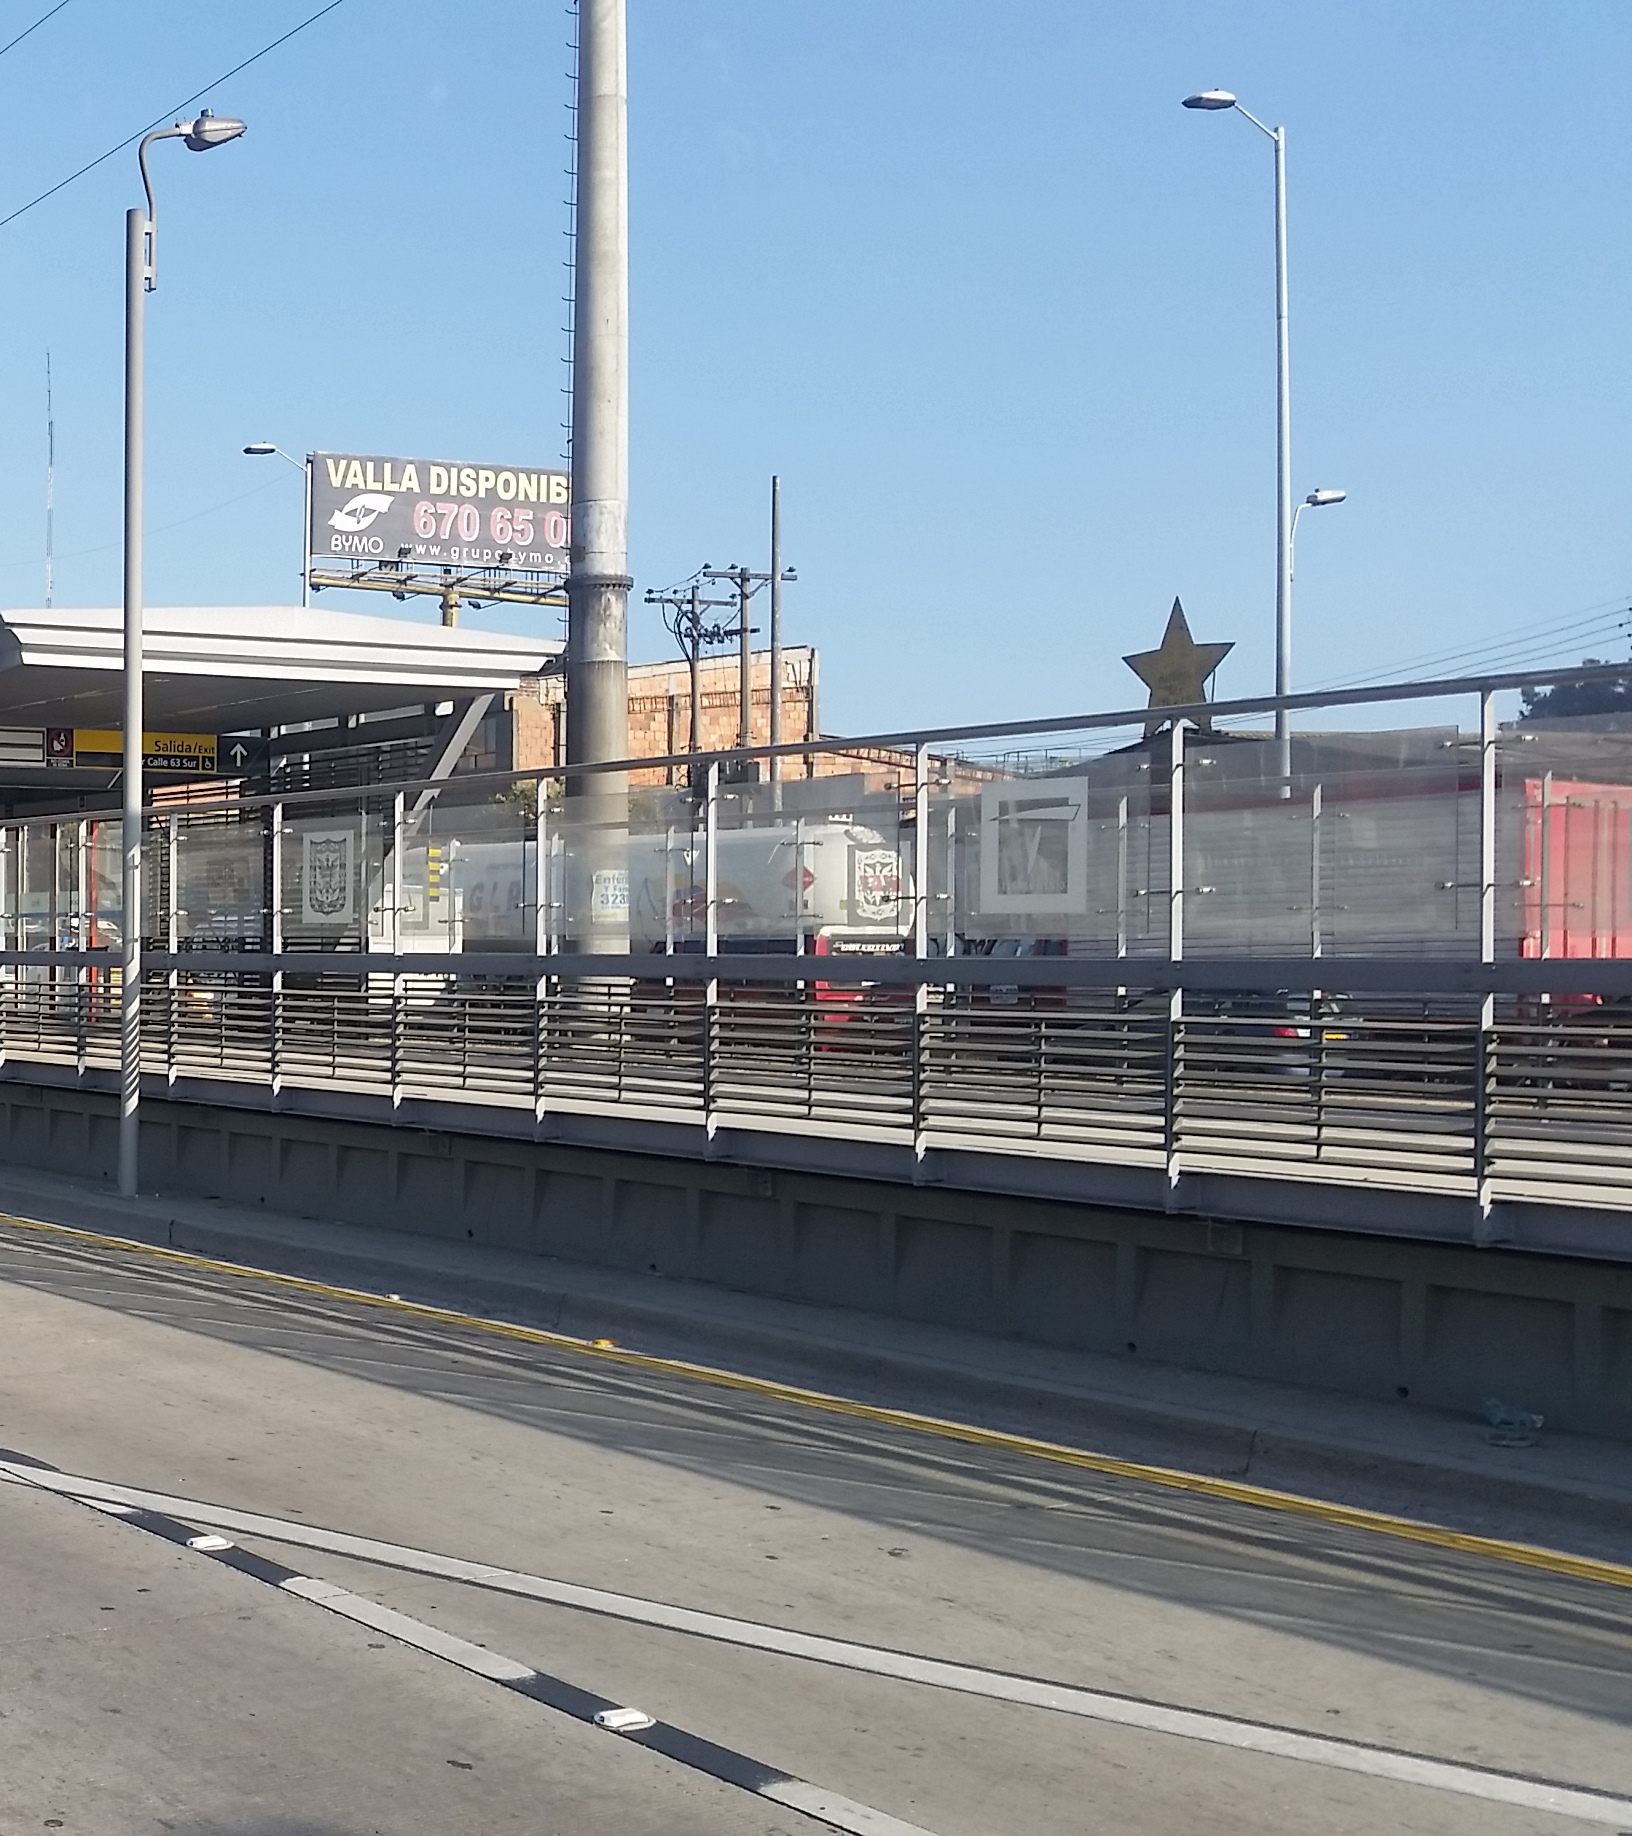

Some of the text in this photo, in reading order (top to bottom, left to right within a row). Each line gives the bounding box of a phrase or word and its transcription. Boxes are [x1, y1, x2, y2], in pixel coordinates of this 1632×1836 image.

[326, 459, 570, 504] VALLA DISPONIB
[413, 501, 480, 542] 670
[490, 508, 535, 546] 65
[330, 534, 384, 554] BYMO
[147, 757, 168, 767] Calle
[170, 758, 180, 767] 63
[182, 758, 197, 768] Sur
